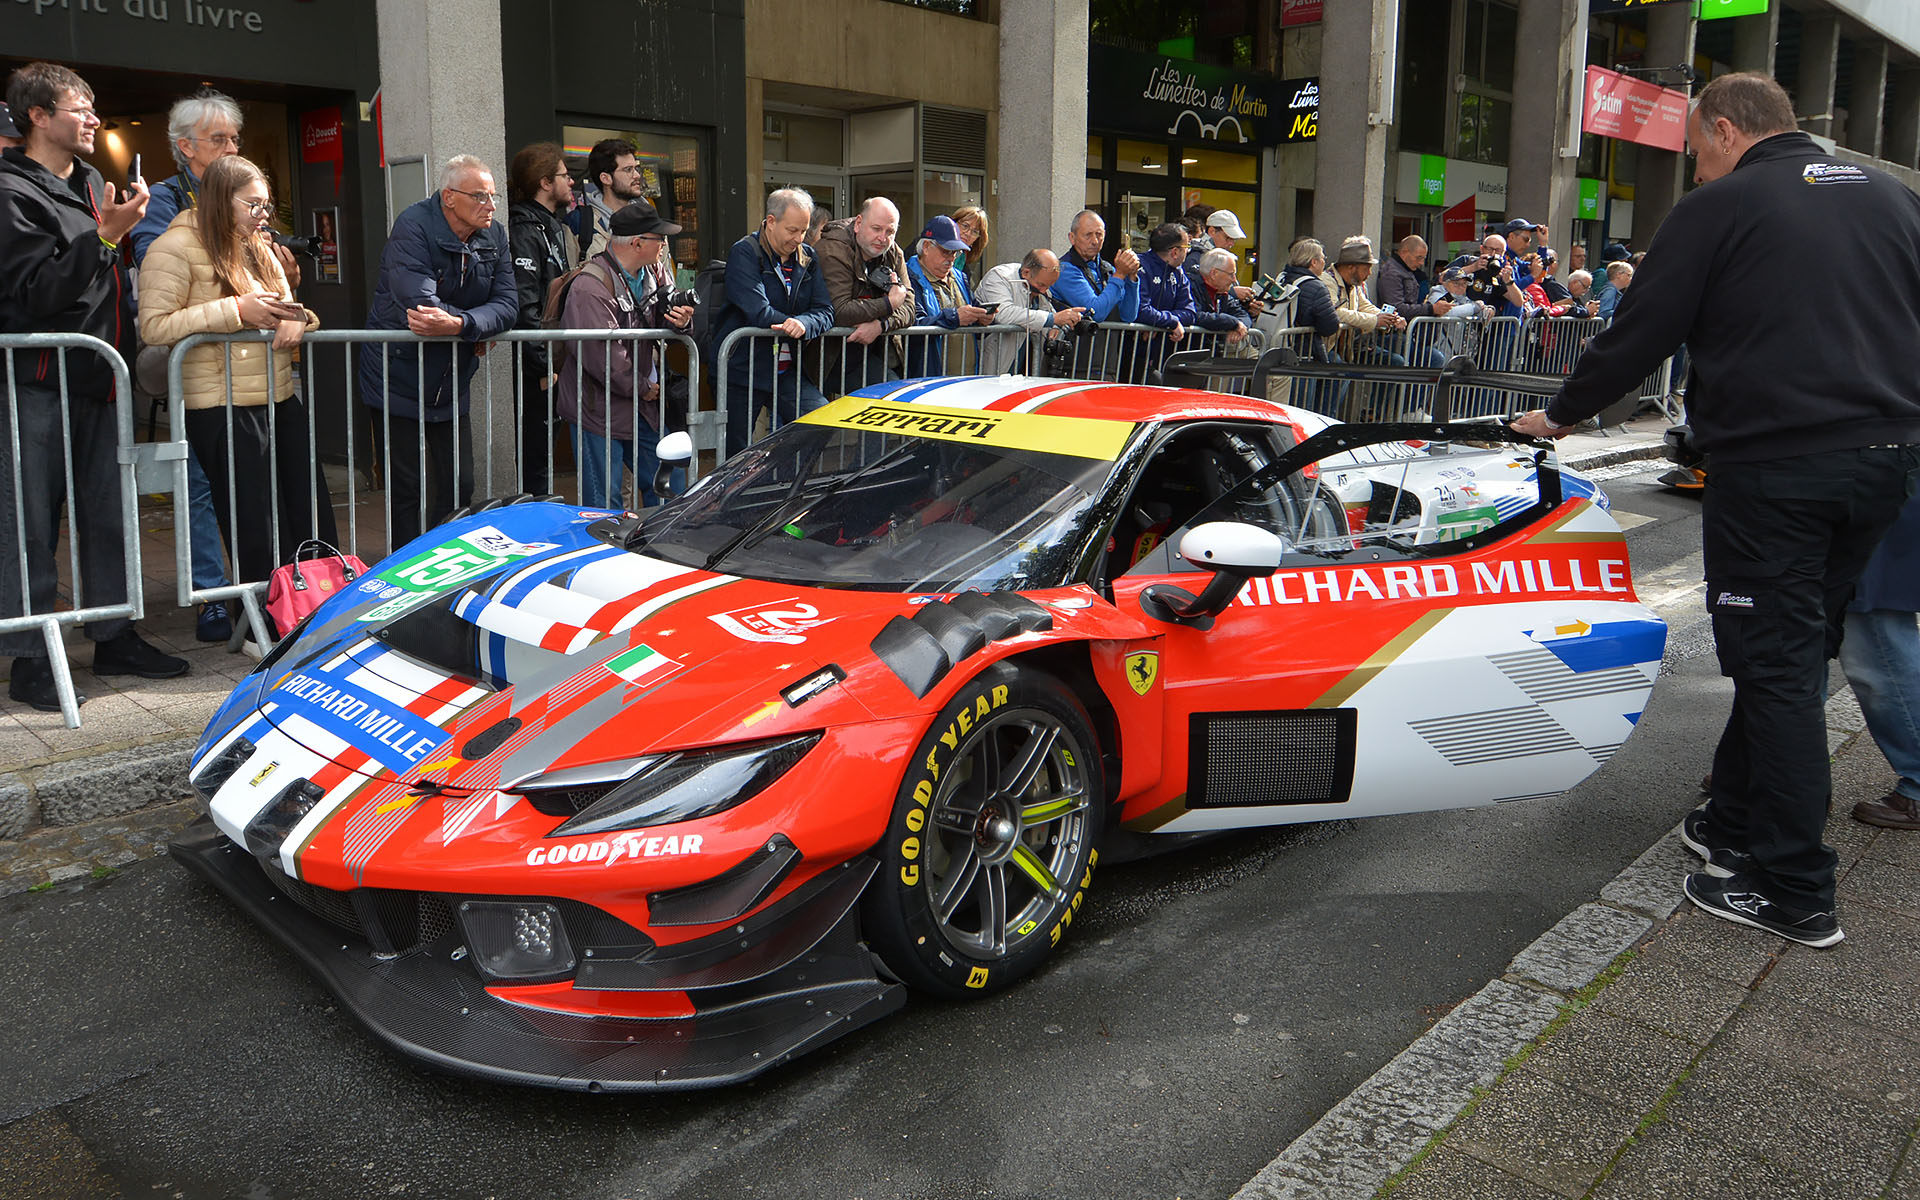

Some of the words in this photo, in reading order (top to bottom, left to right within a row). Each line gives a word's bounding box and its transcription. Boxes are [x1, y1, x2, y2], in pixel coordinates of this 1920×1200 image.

[185, 0, 263, 32] livre
[1160, 59, 1180, 83] Les
[1143, 67, 1207, 108] Lunettes
[1210, 86, 1225, 111] de
[1227, 83, 1268, 118] Martin
[1423, 179, 1443, 195] mgen
[1478, 180, 1503, 195] Mutuelle
[515, 257, 533, 267] CSR
[839, 405, 1003, 439] Ferrari
[1471, 558, 1629, 594] MILLE
[280, 674, 362, 730] RICHARD
[354, 709, 437, 762] MILLE
[1049, 847, 1100, 949] EAGLE
